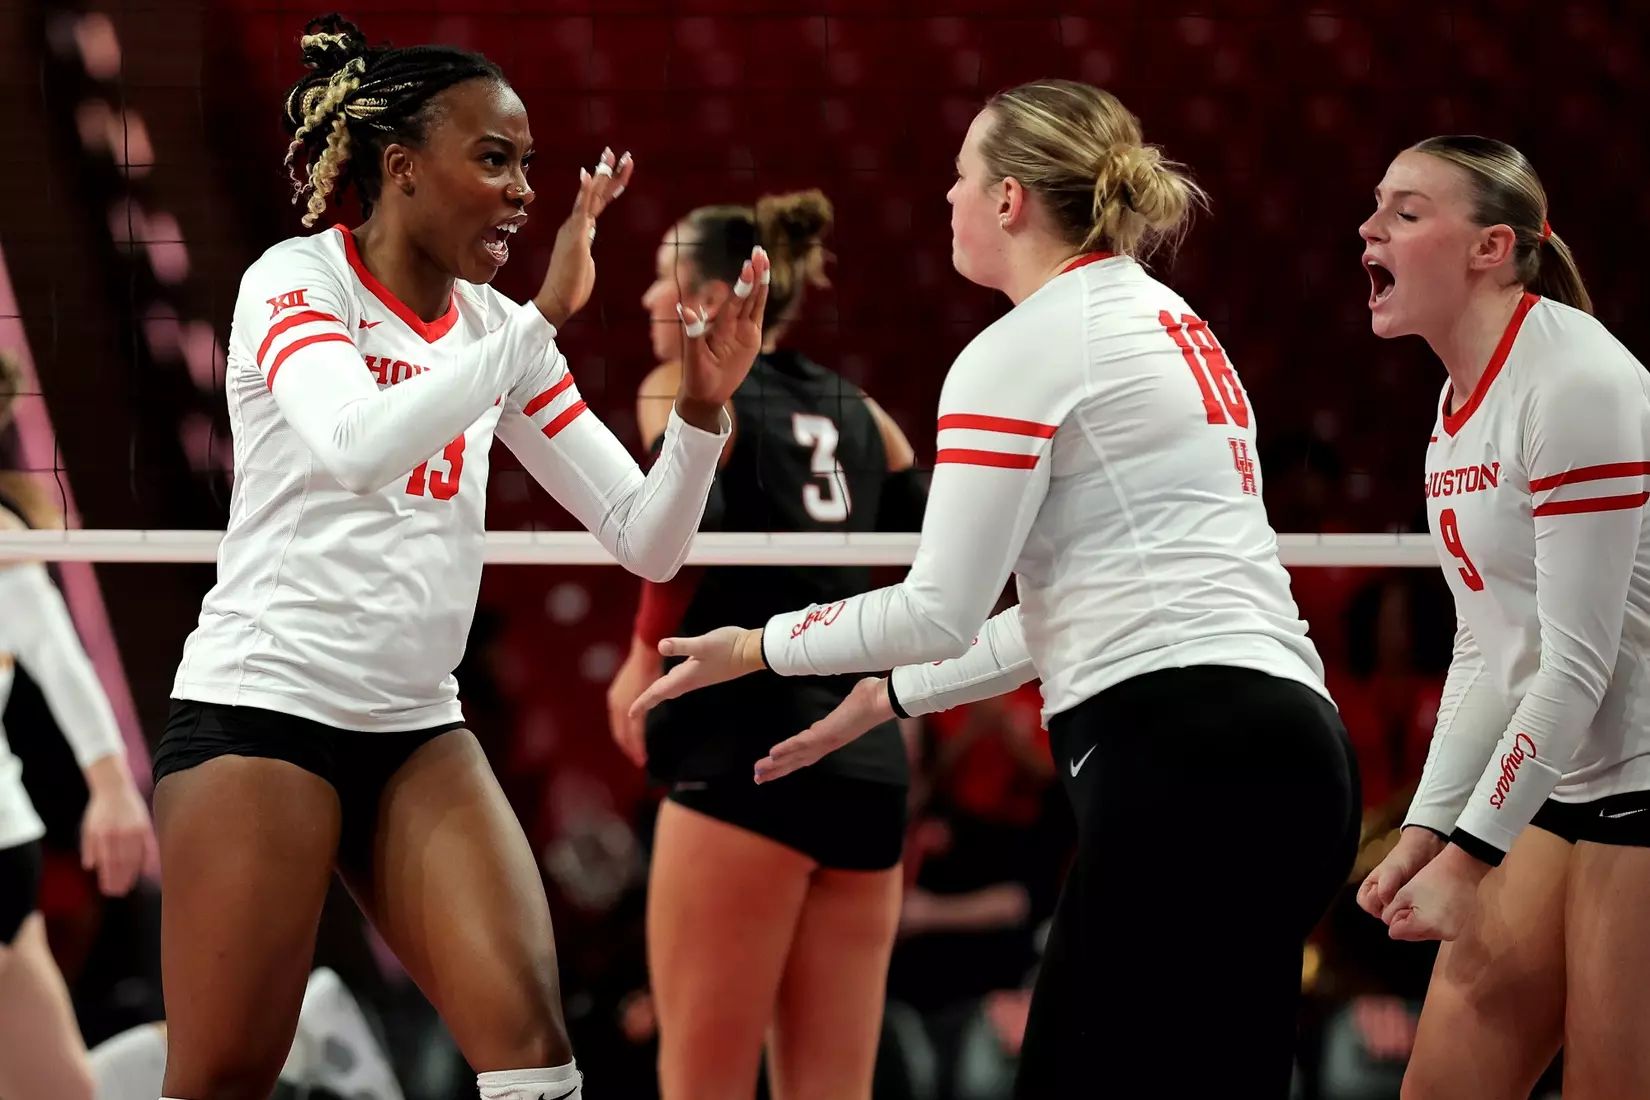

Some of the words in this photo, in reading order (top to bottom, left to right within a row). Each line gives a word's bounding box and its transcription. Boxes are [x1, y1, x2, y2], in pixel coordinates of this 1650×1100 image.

[1158, 309, 1249, 430] 18
[791, 412, 851, 522] 3
[1439, 508, 1485, 592] 9
[1489, 732, 1537, 810] Cougars
